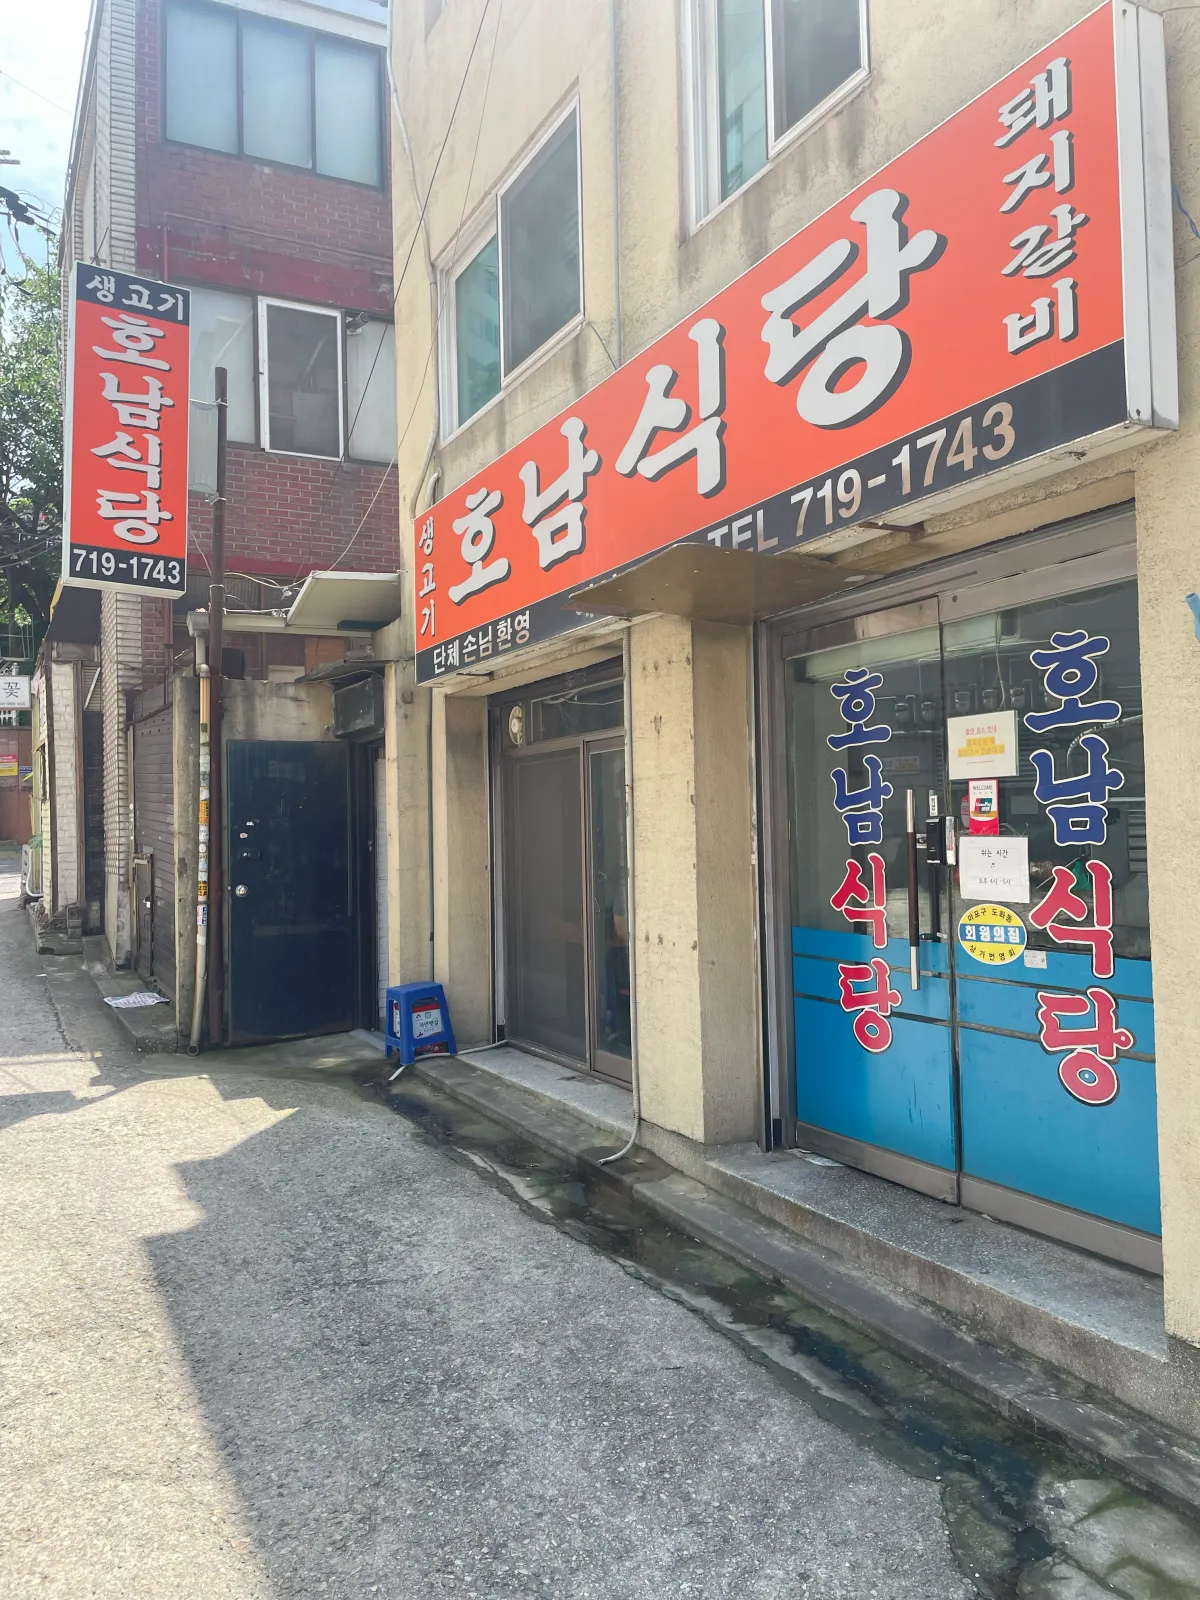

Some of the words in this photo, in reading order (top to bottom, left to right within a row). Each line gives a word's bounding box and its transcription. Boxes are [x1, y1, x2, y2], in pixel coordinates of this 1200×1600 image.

[994, 57, 1089, 354] 돼지갈비
[86, 275, 183, 321] 생고기
[90, 313, 174, 544] 호남식당
[448, 188, 946, 605] 호남식당
[707, 509, 778, 552] TEL
[791, 401, 1015, 537] 719-1743
[73, 548, 181, 585] 719-1743
[418, 515, 436, 637] 생고기
[433, 639, 460, 674] 단체
[462, 626, 493, 663] 손님
[496, 610, 530, 651] 환영
[826, 666, 903, 1054] 호남식당
[979, 877, 988, 885] 오후
[990, 878, 998, 886] 4시
[981, 849, 993, 858] 쉬는
[996, 849, 1009, 859] 시간
[1023, 629, 1135, 1105] 호남식당
[967, 907, 987, 922] 마포구
[991, 908, 1013, 923] 도화동
[969, 944, 1016, 962] 상가번영회
